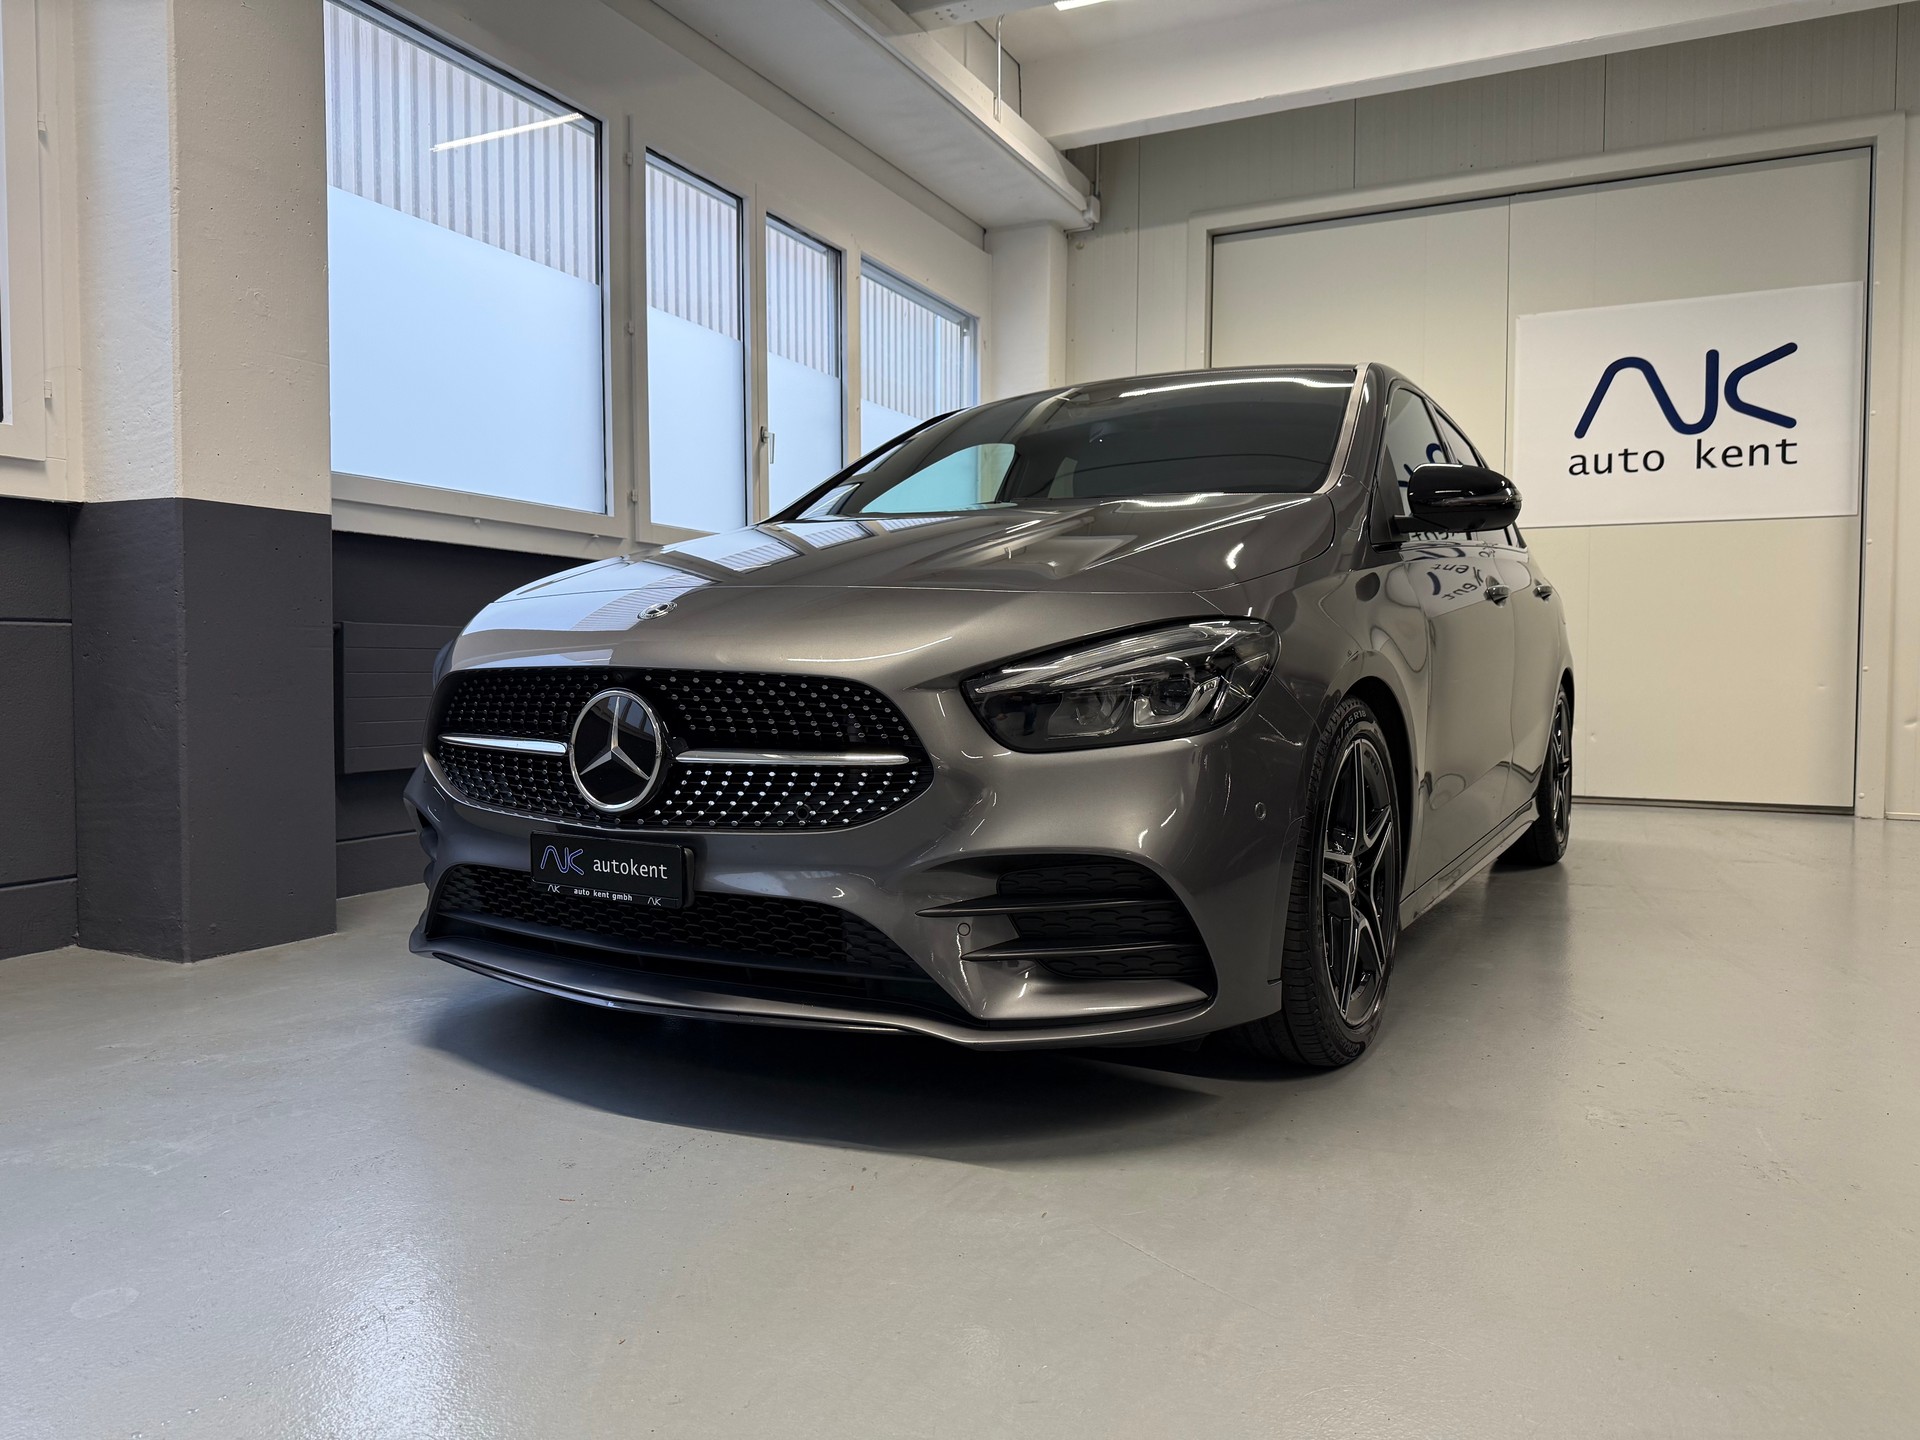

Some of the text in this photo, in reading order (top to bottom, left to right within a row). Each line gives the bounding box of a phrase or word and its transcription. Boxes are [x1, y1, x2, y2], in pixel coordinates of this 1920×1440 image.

[1568, 438, 1798, 476] auto kent
[593, 858, 668, 879] autokent
[574, 888, 590, 896] auto
[593, 889, 610, 899] kent
[612, 893, 633, 902] gmbh
